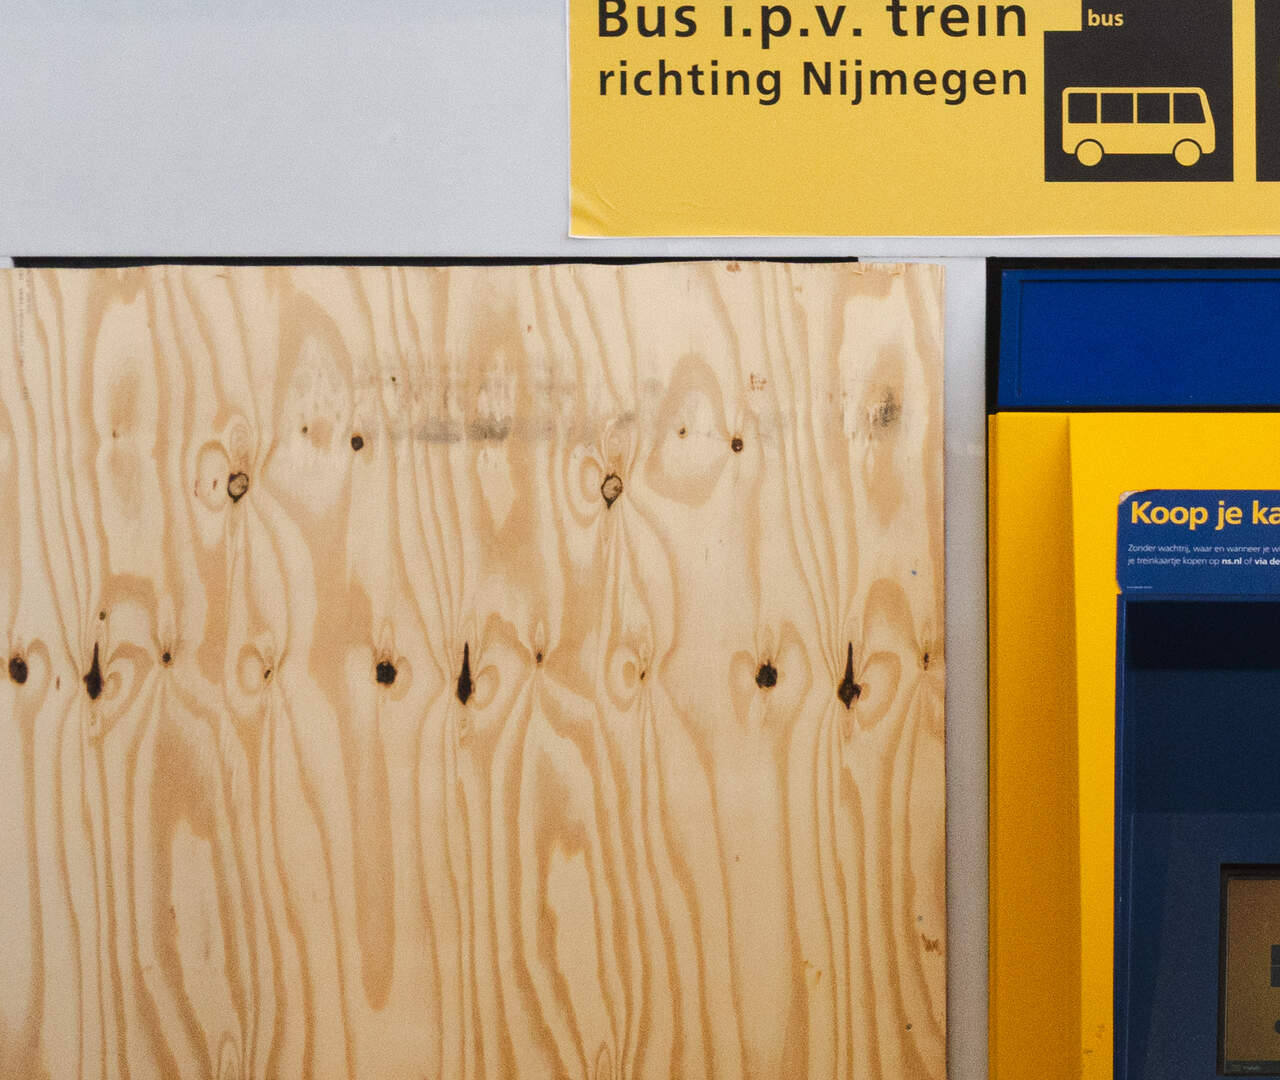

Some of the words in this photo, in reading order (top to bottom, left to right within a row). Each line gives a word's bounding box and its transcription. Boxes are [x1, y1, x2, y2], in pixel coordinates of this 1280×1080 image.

[598, 0, 698, 37] Bus
[724, 0, 862, 49] i.p.v.
[887, 0, 1027, 37] trein
[1087, 9, 1124, 27] bus
[599, 59, 781, 105] richting
[803, 59, 1027, 105] Nijmegen
[1131, 501, 1208, 530] Koop
[1215, 501, 1243, 531] je
[1128, 544, 1156, 552] Zonder
[1182, 557, 1207, 566] kopen
[1209, 558, 1220, 567] op
[1222, 557, 1242, 565] ns.nl
[1255, 557, 1268, 566] via
[1269, 557, 1280, 566] de
